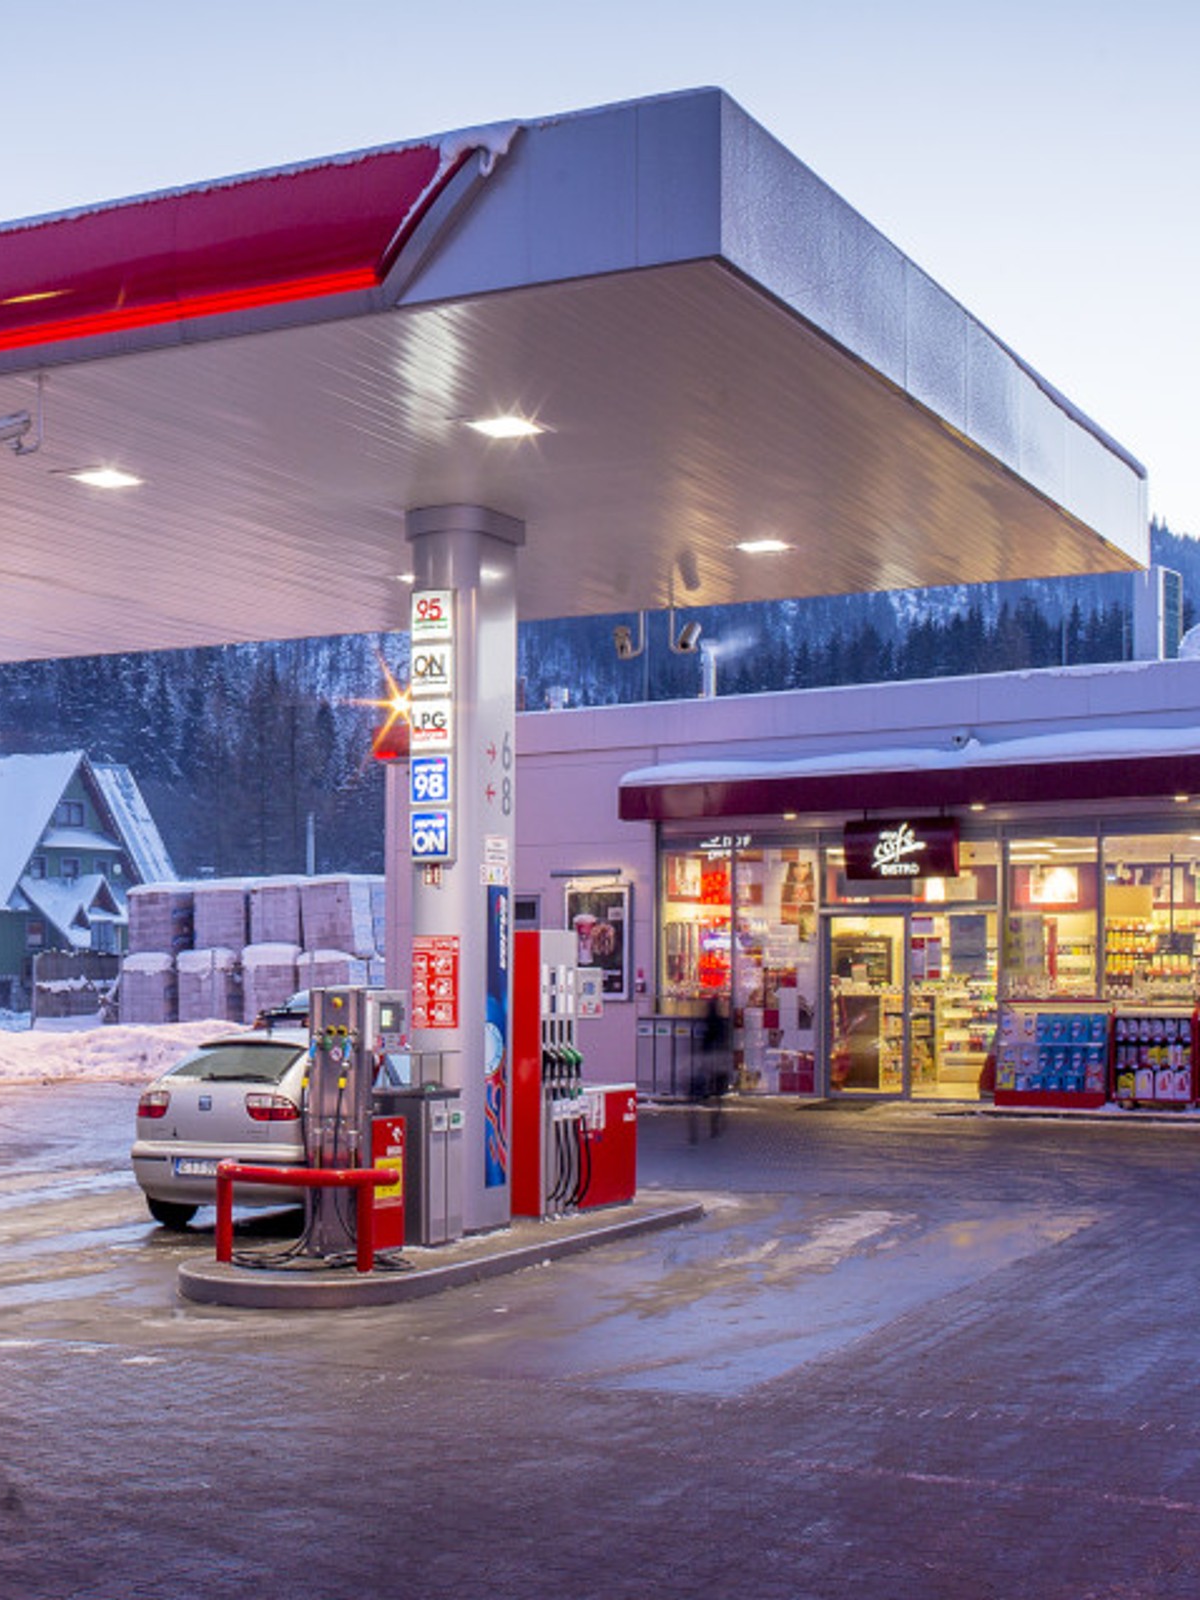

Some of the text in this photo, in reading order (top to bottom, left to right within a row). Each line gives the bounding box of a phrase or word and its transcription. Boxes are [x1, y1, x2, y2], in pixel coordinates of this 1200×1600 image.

[416, 598, 443, 622] 95
[414, 654, 446, 678] ON
[411, 711, 447, 732] LPG
[502, 731, 512, 771] 6
[414, 773, 445, 799] 98
[502, 776, 511, 816] 8
[413, 830, 446, 853] ON
